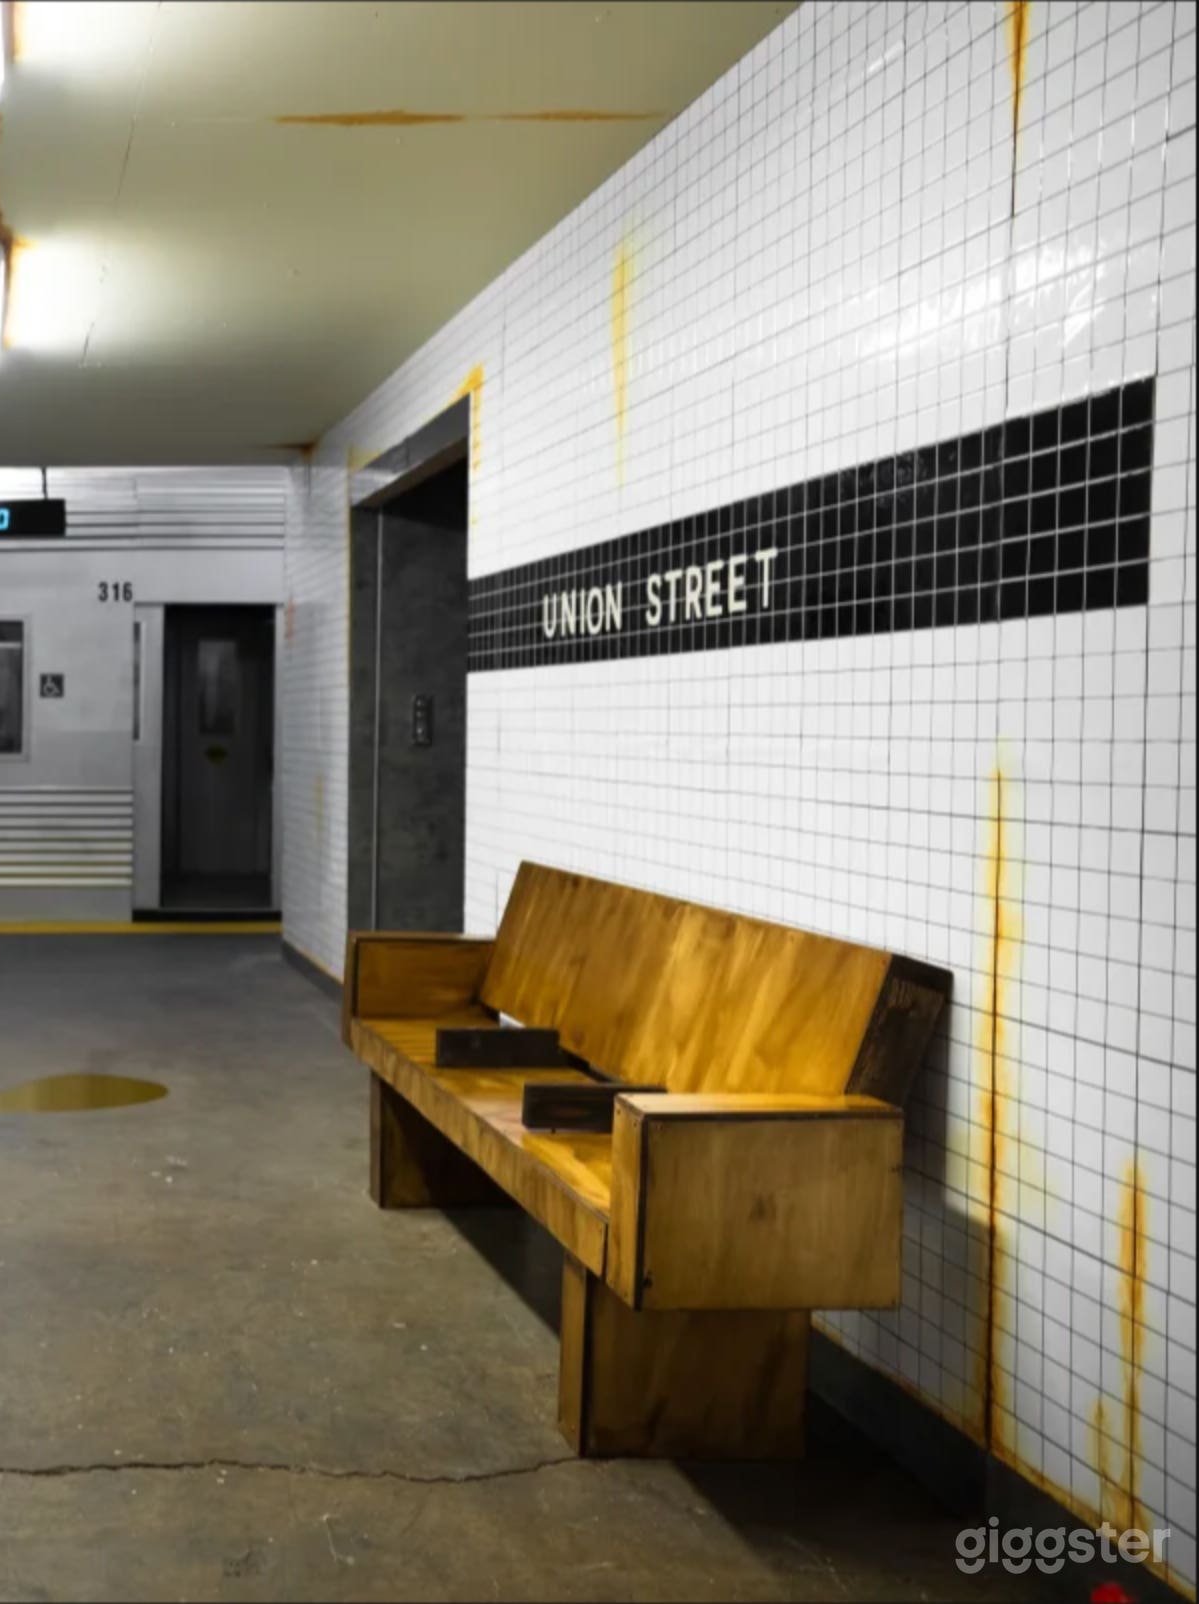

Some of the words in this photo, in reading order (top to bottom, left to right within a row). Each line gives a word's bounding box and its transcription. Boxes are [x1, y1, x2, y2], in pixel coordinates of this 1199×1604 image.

[98, 581, 133, 602] 316
[542, 580, 624, 639] UNION
[645, 547, 778, 626] STREET
